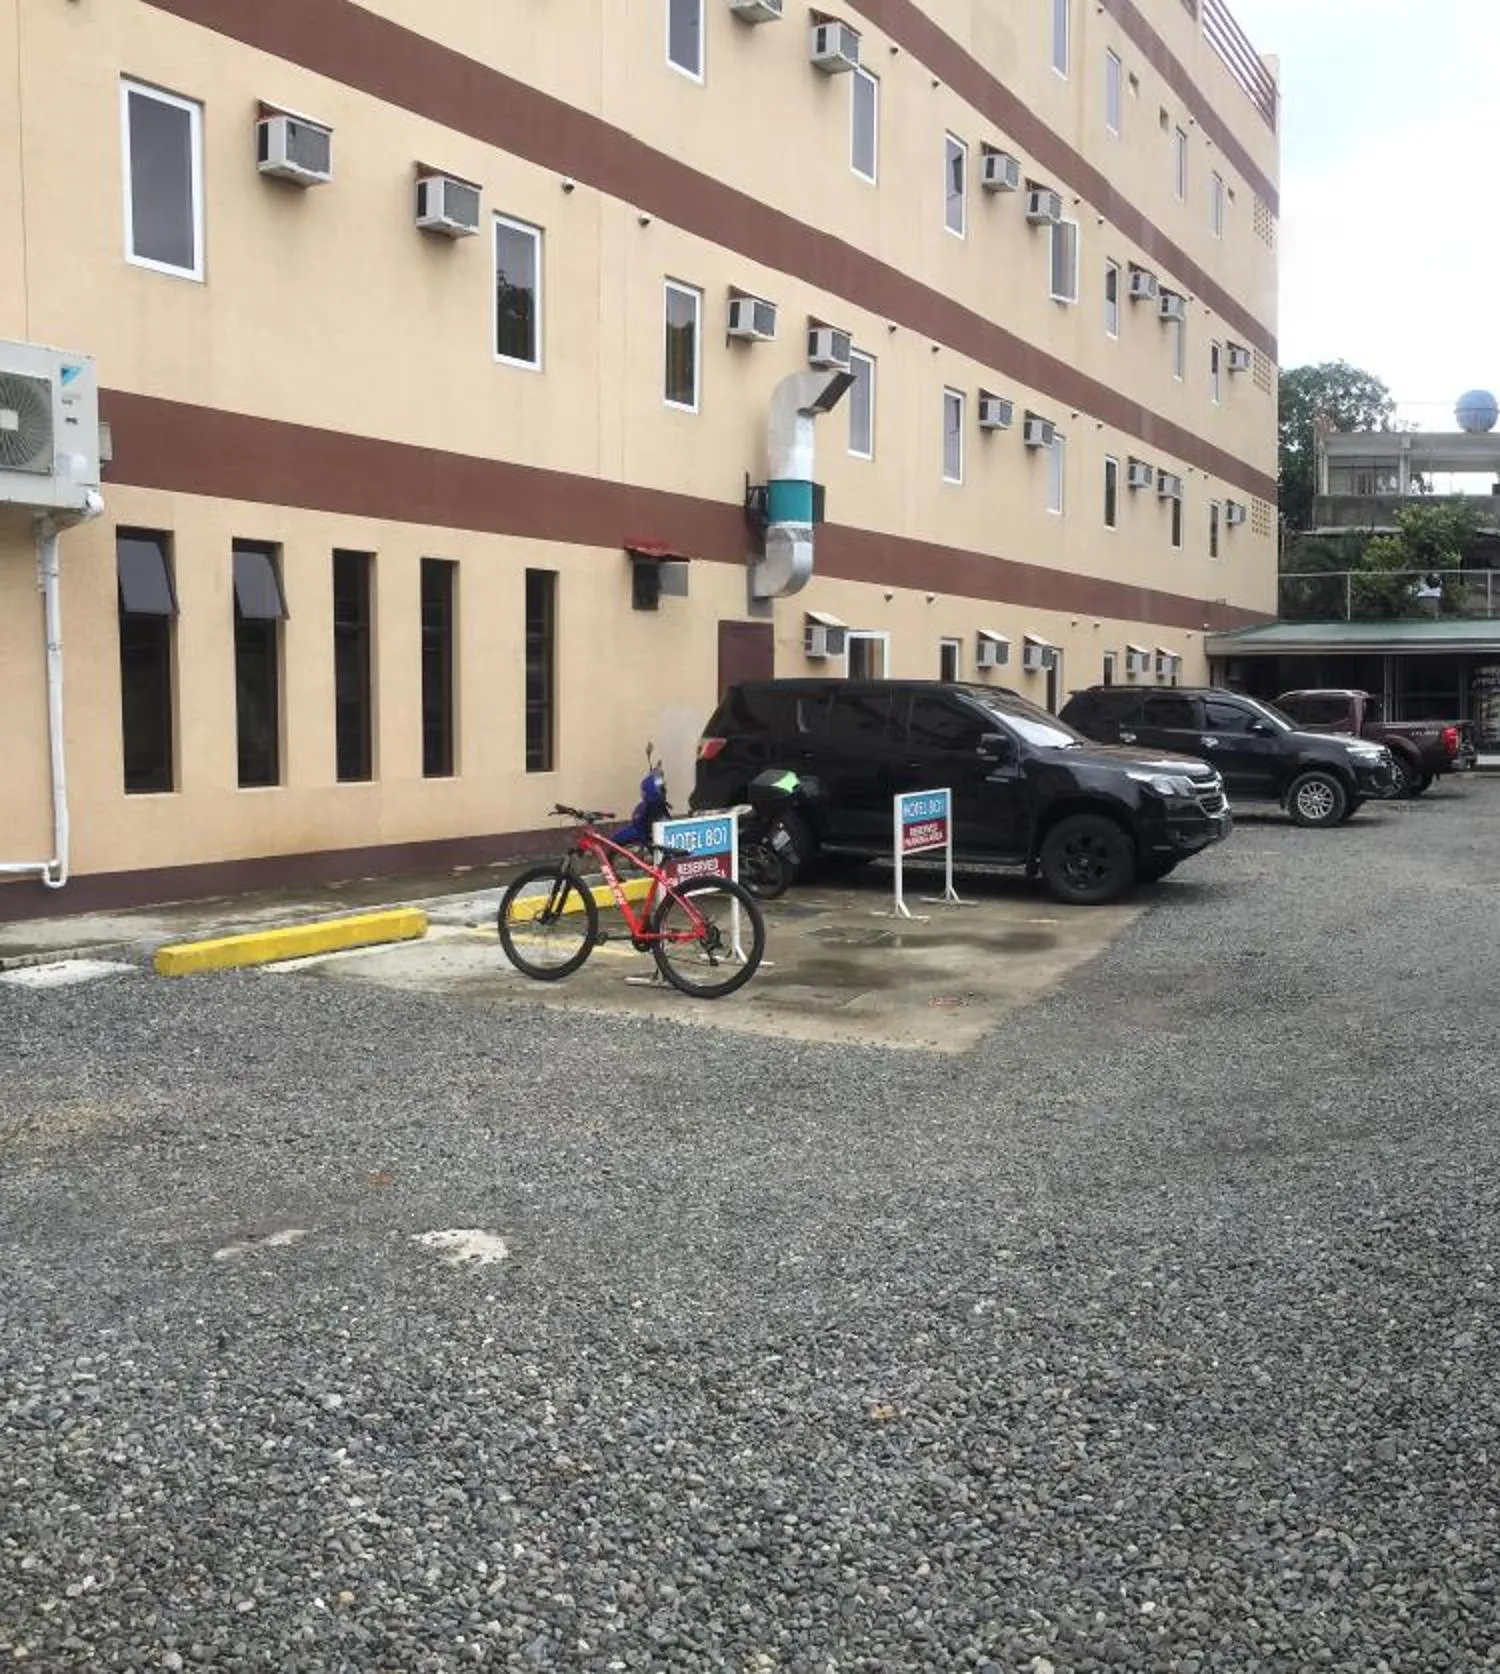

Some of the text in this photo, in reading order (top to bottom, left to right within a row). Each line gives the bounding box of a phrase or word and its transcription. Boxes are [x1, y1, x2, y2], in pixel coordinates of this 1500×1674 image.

[903, 801, 927, 817] HOTEL
[665, 826, 727, 852] HOTEL 801
[677, 857, 719, 875] RESERVED
